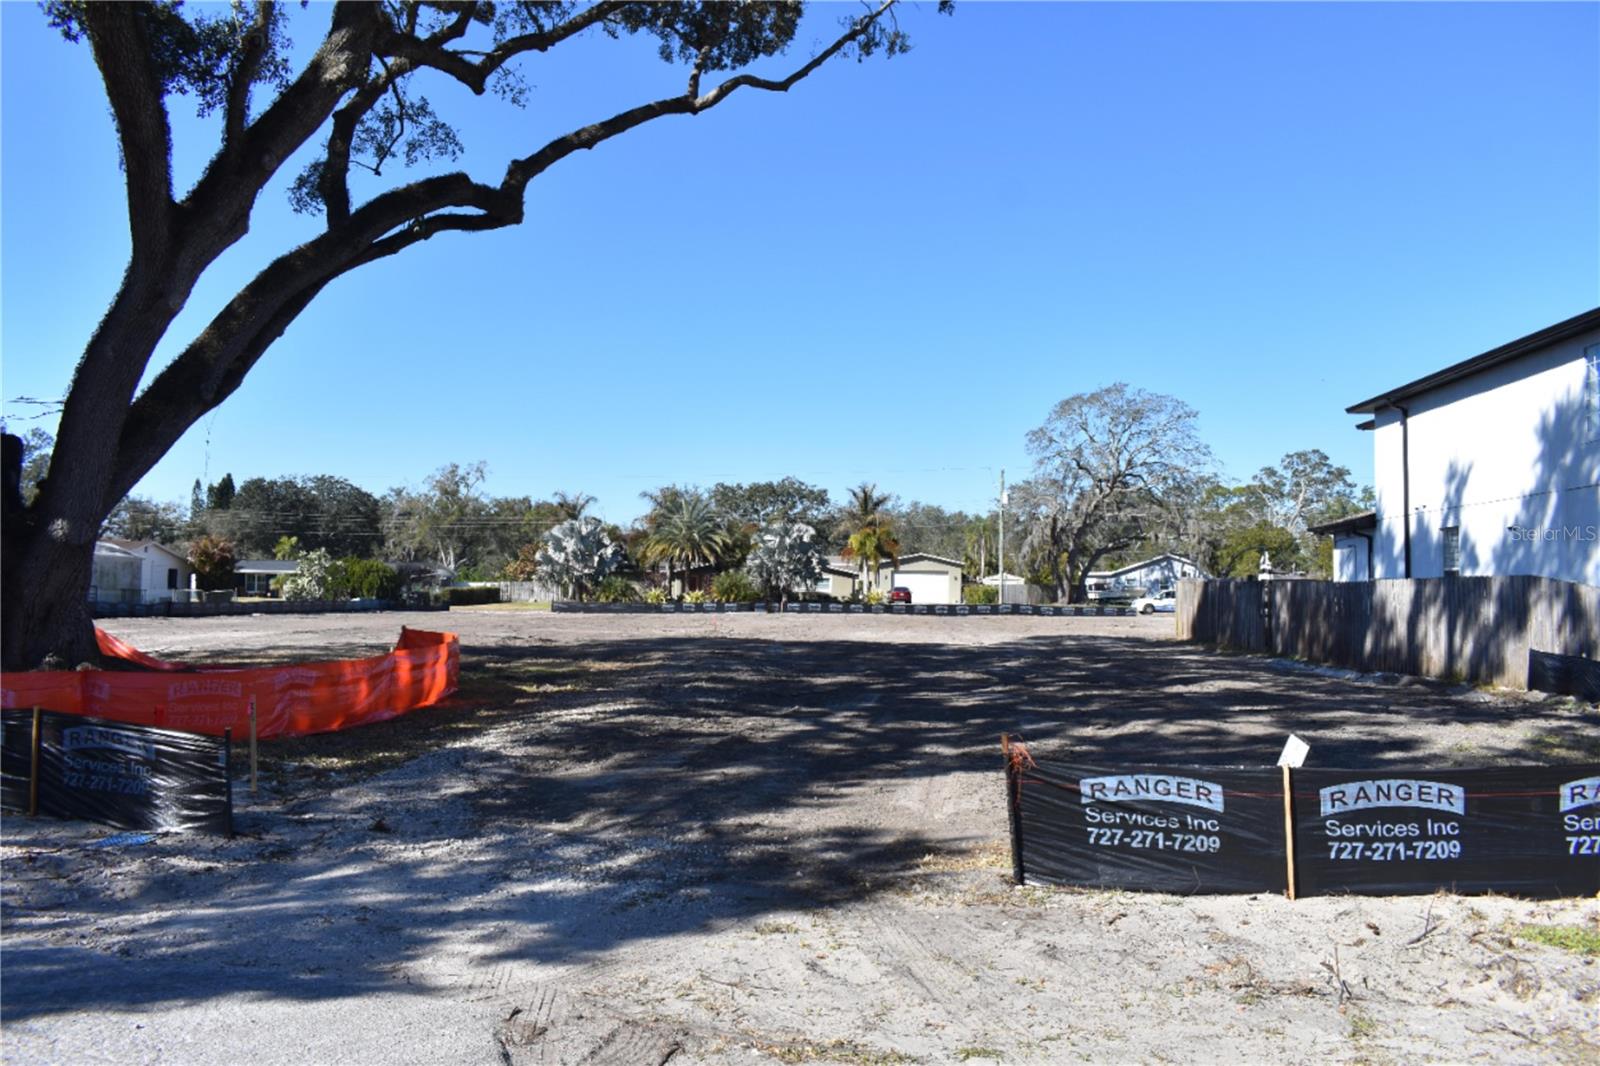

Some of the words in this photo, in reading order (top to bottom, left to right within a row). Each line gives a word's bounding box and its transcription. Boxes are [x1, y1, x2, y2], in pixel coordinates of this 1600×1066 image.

[130, 760, 152, 777] Inc
[1089, 778, 1214, 804] RANGER
[1329, 783, 1455, 809] RANGER
[1085, 806, 1180, 829] Services
[1186, 814, 1220, 832] Inc
[1325, 819, 1420, 838] Services
[1427, 818, 1460, 837] Inc
[1086, 827, 1220, 854] 727-271-7209
[1327, 840, 1461, 861] 727-271-7209
